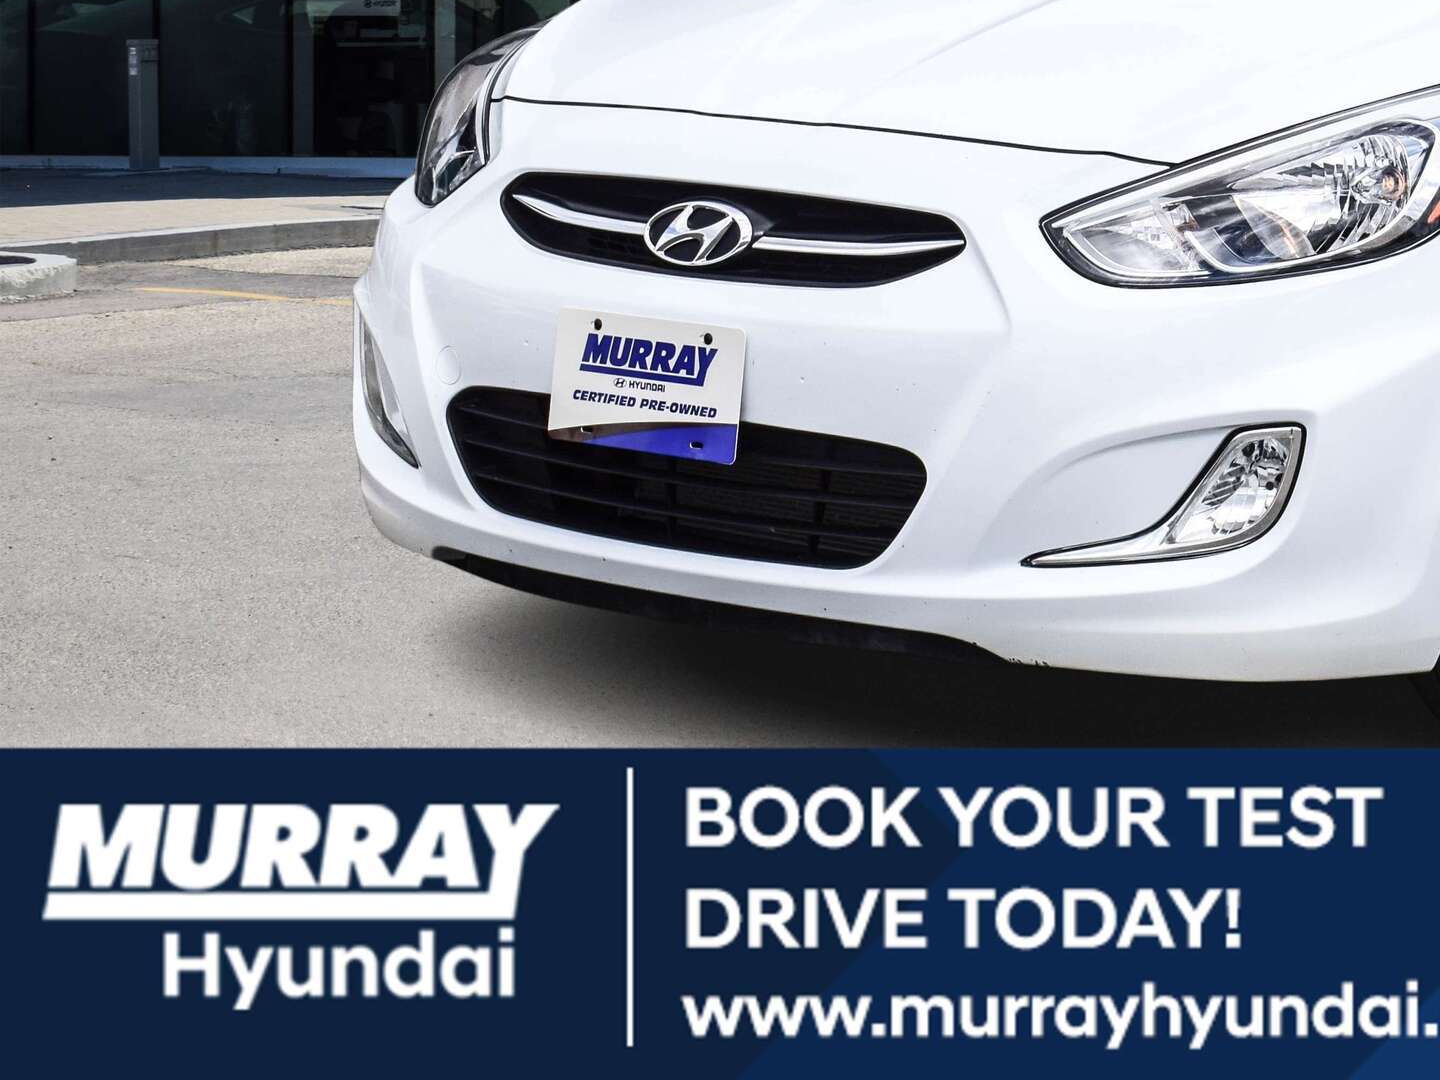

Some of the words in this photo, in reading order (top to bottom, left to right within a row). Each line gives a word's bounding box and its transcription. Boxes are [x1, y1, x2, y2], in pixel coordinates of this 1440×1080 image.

[580, 332, 718, 383] MURRAY
[629, 380, 666, 393] HYUNDAI
[572, 389, 636, 408] CERTIFIED
[639, 398, 718, 418] PRE-OWNED
